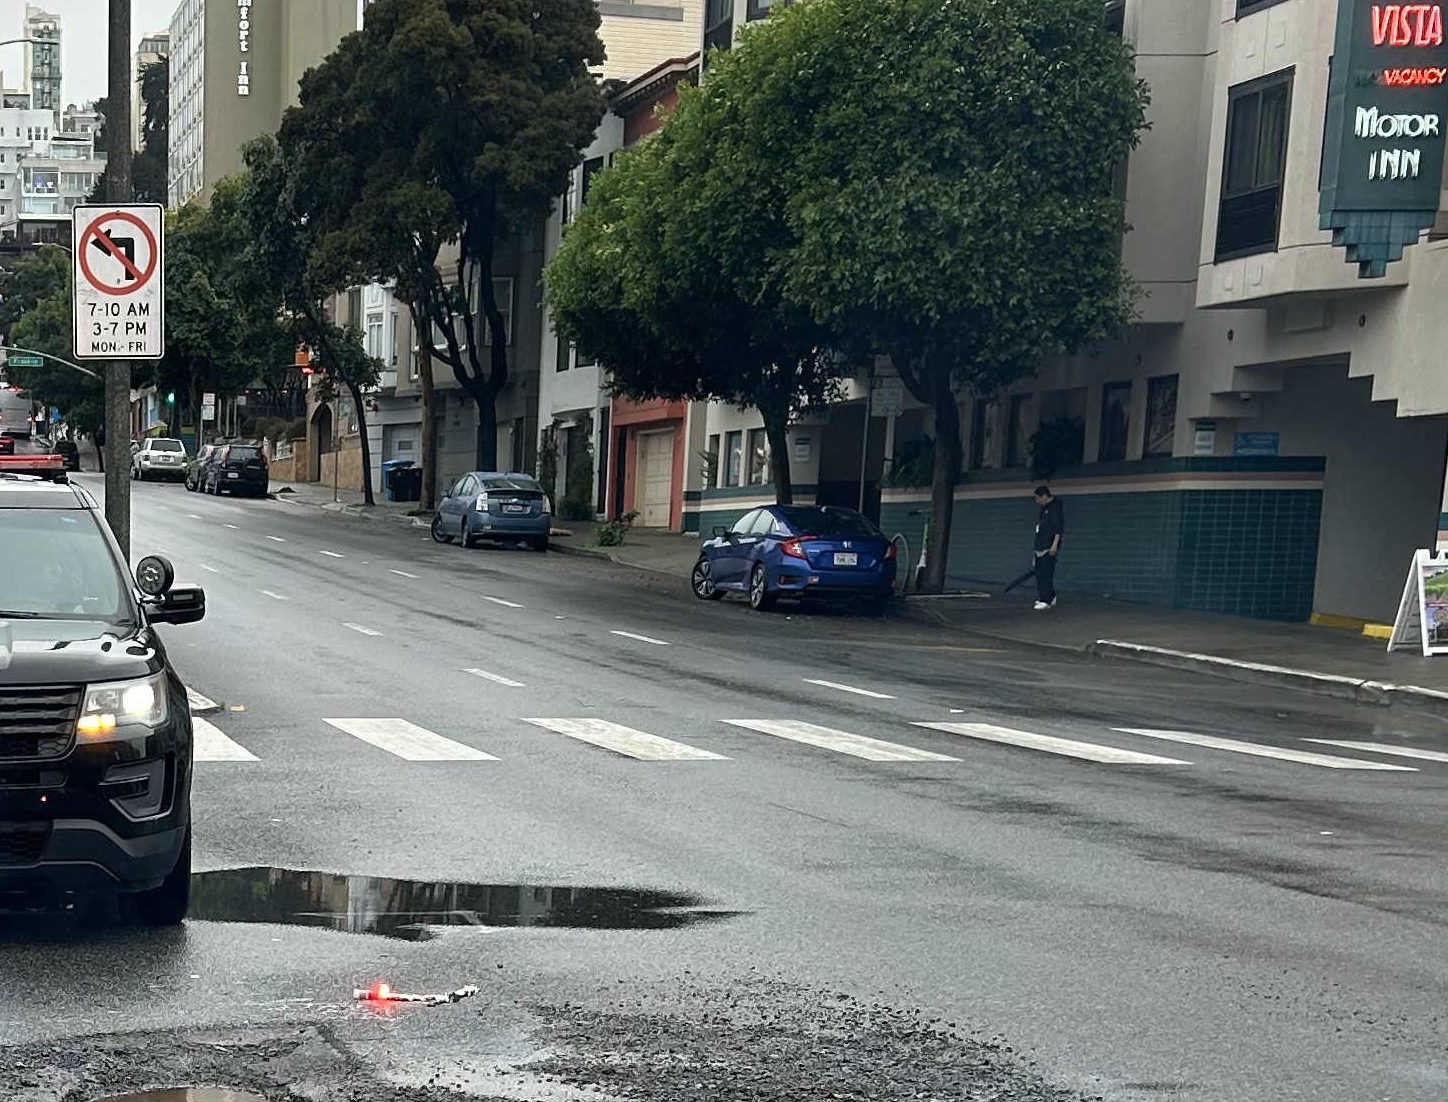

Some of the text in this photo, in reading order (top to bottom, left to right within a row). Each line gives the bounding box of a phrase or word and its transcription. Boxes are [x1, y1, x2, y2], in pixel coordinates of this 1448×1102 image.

[1371, 5, 1443, 46] VISTA
[237, 61, 249, 95] Inn
[1383, 67, 1447, 86] VACANCY
[1368, 148, 1421, 181] INN
[88, 302, 150, 316] 7-10 AM
[93, 322, 146, 335] 3-7 PM
[128, 341, 146, 353] FRI
